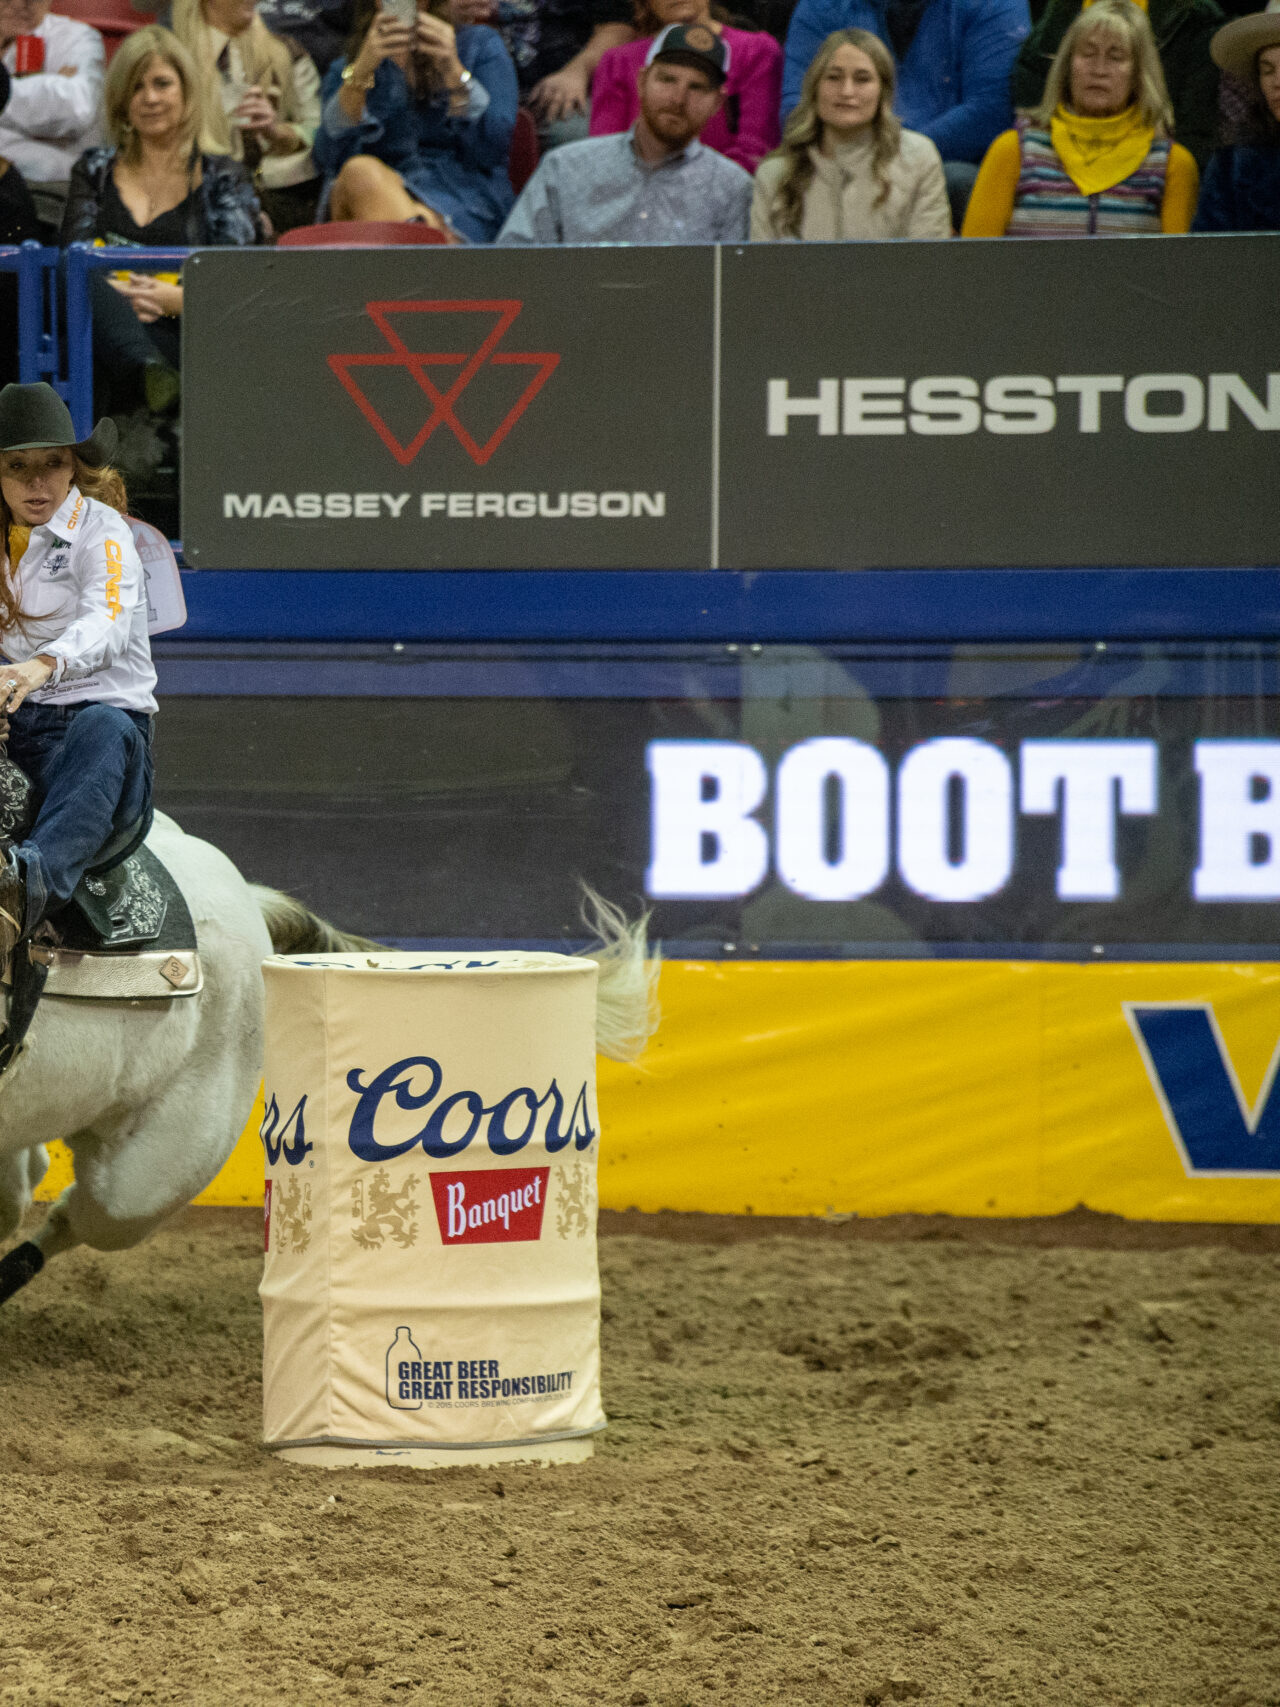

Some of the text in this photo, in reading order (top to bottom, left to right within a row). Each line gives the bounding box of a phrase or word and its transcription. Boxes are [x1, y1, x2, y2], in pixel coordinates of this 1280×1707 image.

[767, 373, 1280, 436] HESSTON
[223, 491, 666, 518] MASSEY FERGUSON
[644, 736, 1160, 902] BOOT
[346, 1055, 596, 1162] Coors
[446, 1175, 543, 1238] Banquet
[398, 1359, 500, 1380] GREAT BEER
[398, 1370, 573, 1400] GREAT RESPONSIBILITY
